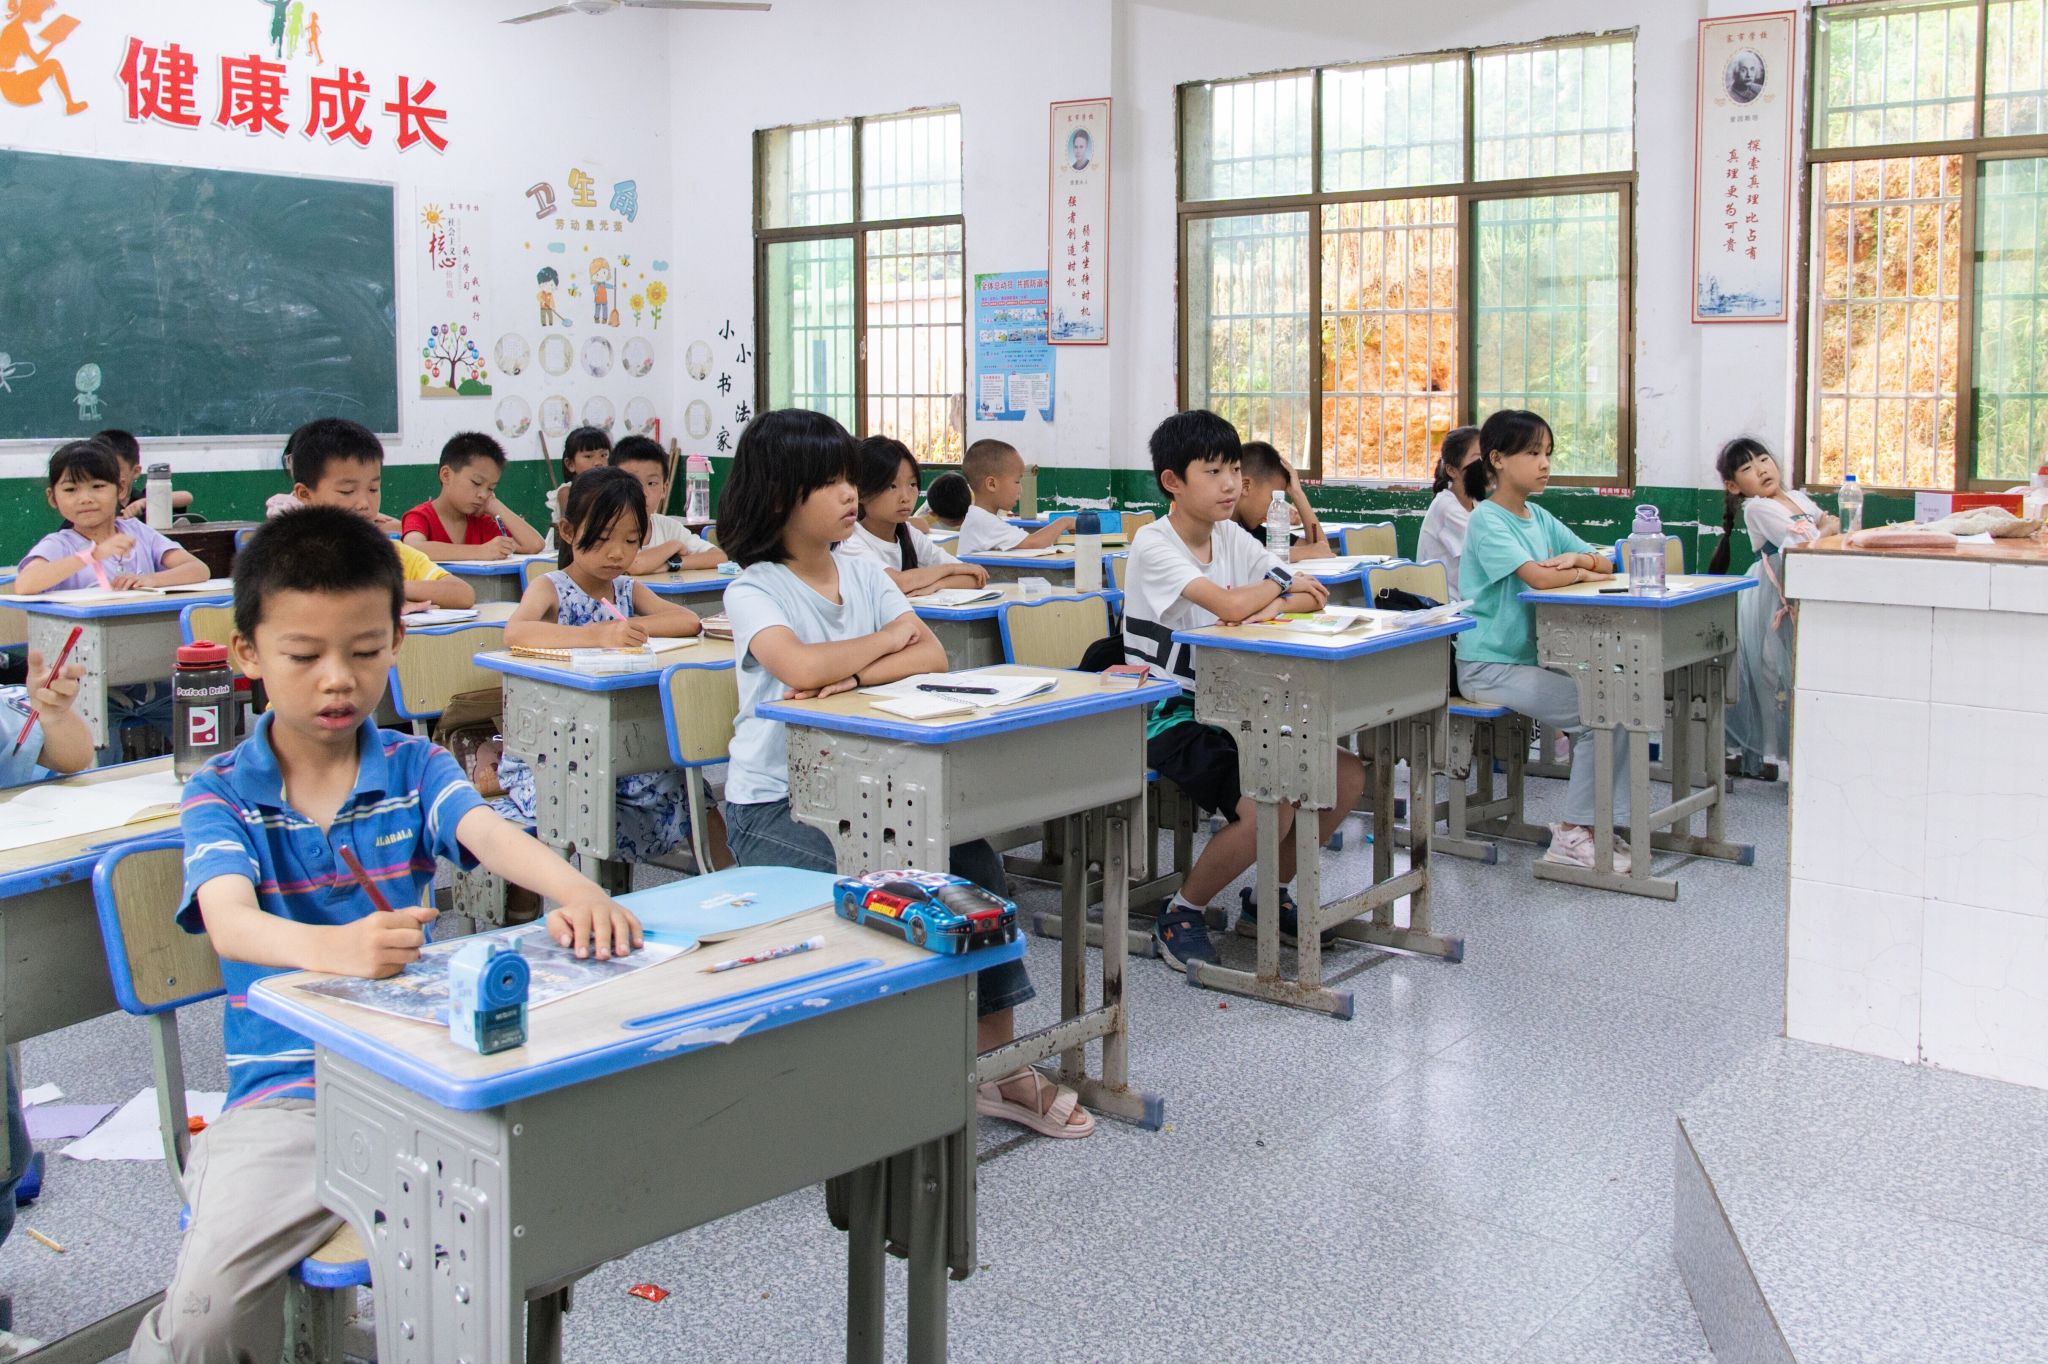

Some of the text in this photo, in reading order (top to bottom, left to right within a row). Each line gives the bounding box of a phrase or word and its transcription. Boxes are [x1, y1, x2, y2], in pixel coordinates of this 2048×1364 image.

[119, 36, 449, 152] 健康成长
[525, 168, 638, 223] 卫生角
[1745, 138, 1761, 260] 探索真理比占有
[428, 230, 457, 271] 核心
[555, 219, 623, 232] 劳动最光荣
[717, 319, 752, 452] 小小书法家
[176, 684, 230, 697] Perfect Drink
